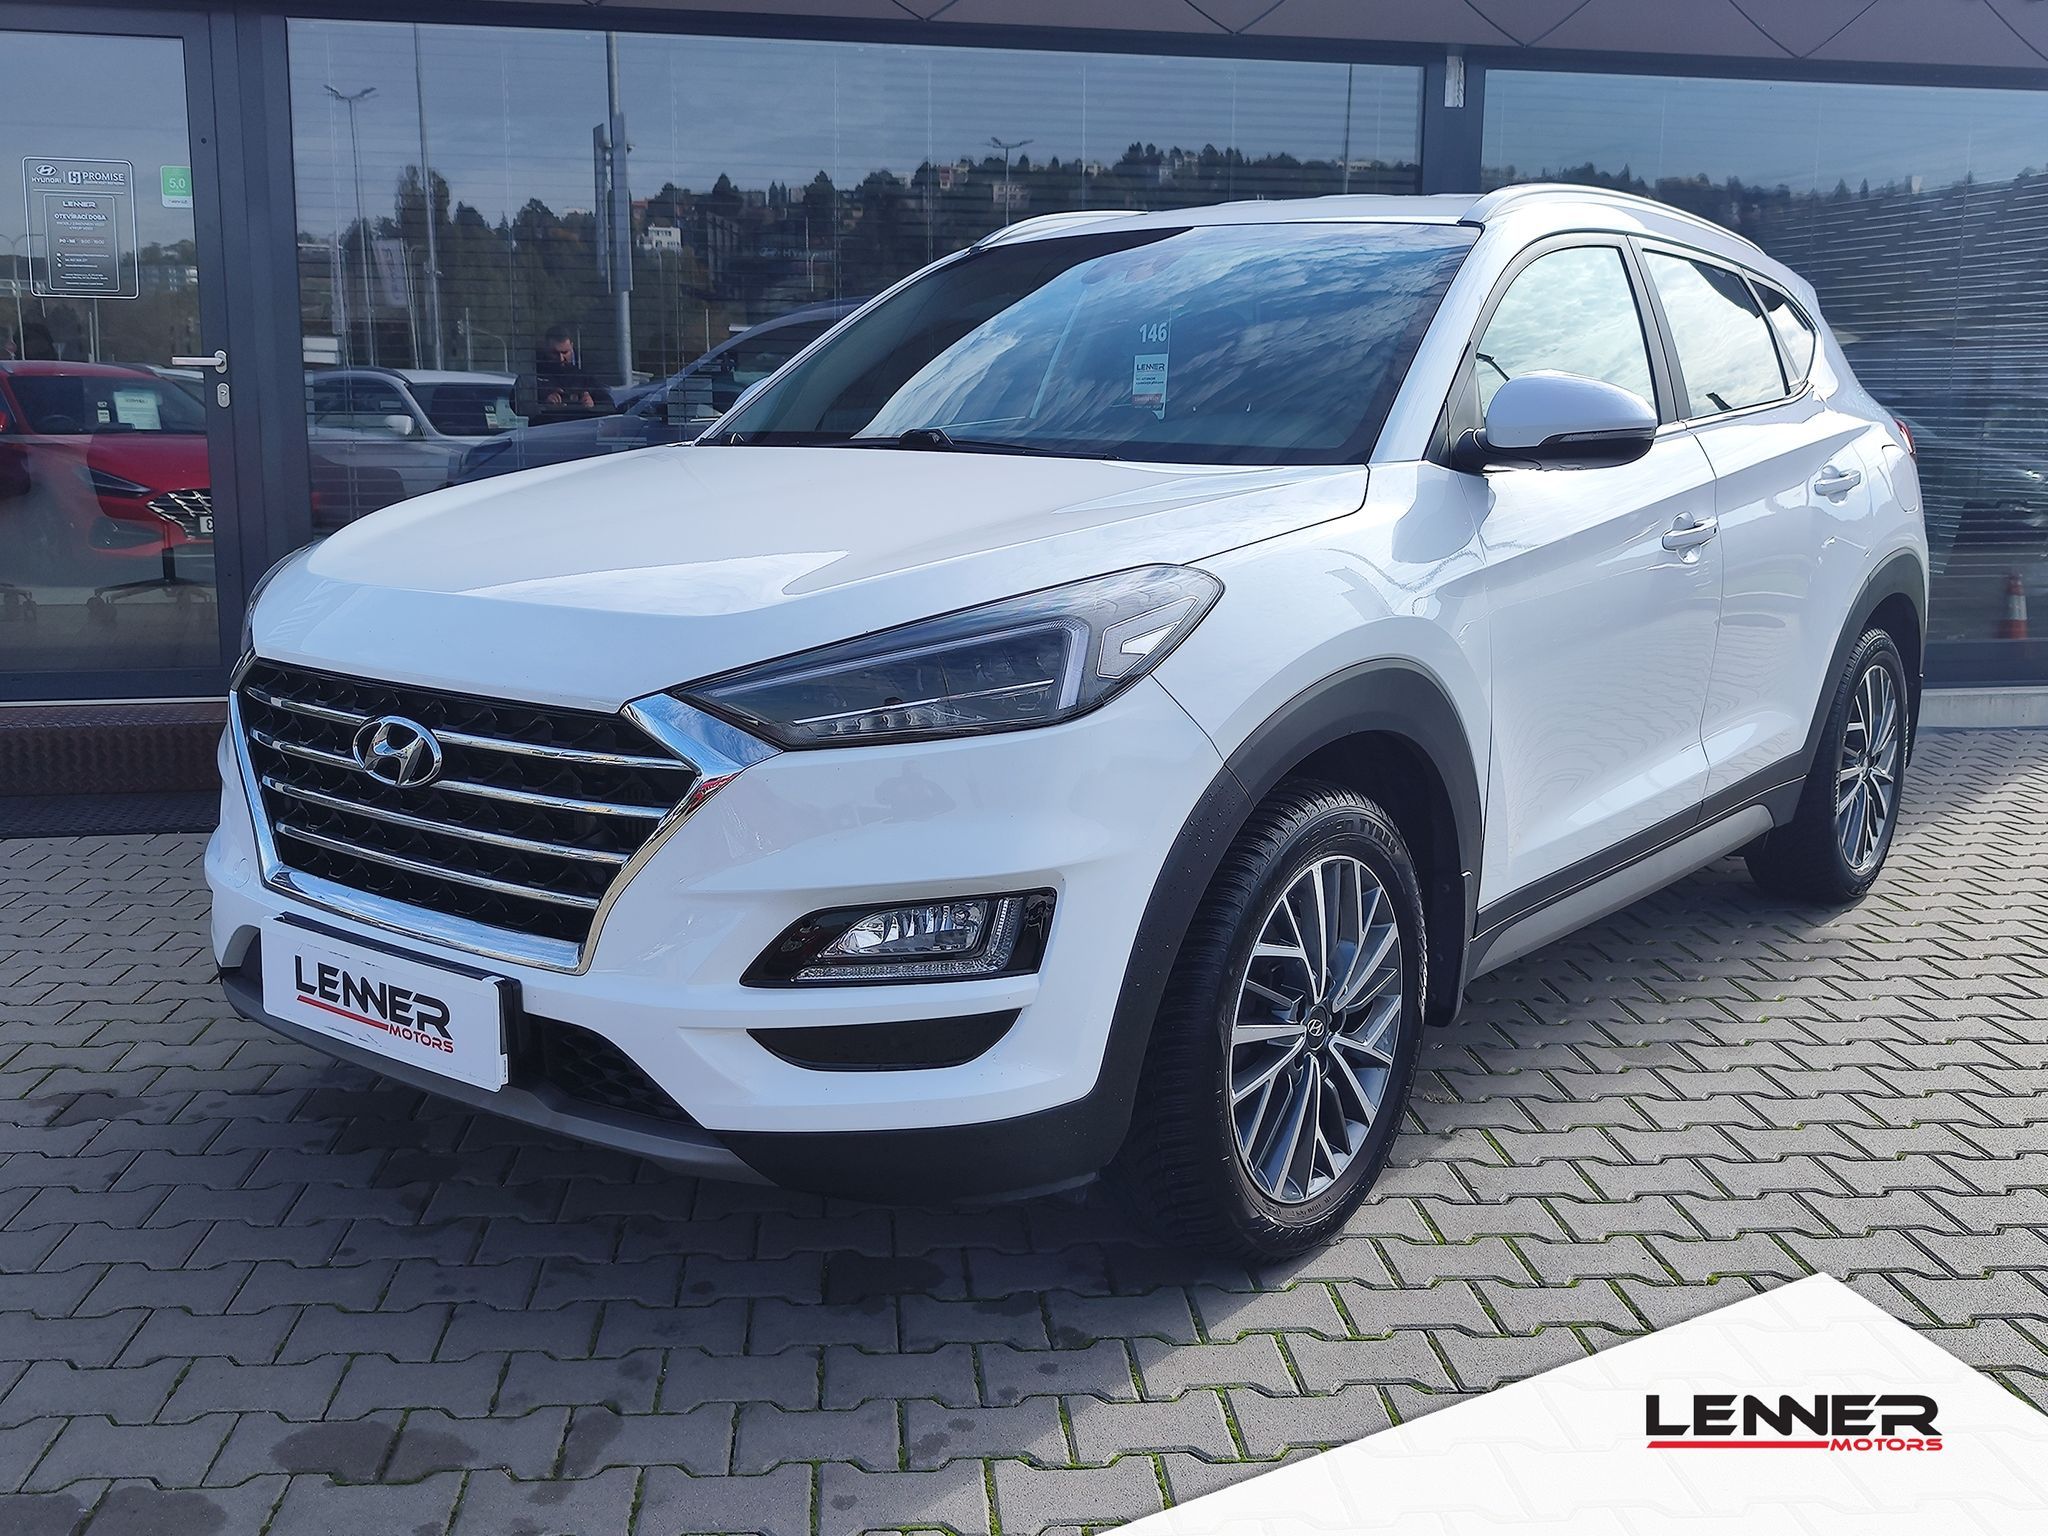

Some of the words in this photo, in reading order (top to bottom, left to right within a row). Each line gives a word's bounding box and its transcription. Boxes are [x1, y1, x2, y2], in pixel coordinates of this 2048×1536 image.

[82, 172, 124, 181] PROMISE
[62, 200, 96, 208] LENNER
[1140, 323, 1168, 343] 146
[1136, 363, 1165, 371] LENNER
[294, 955, 453, 1040] LENNER
[389, 1024, 454, 1053] MOTORS
